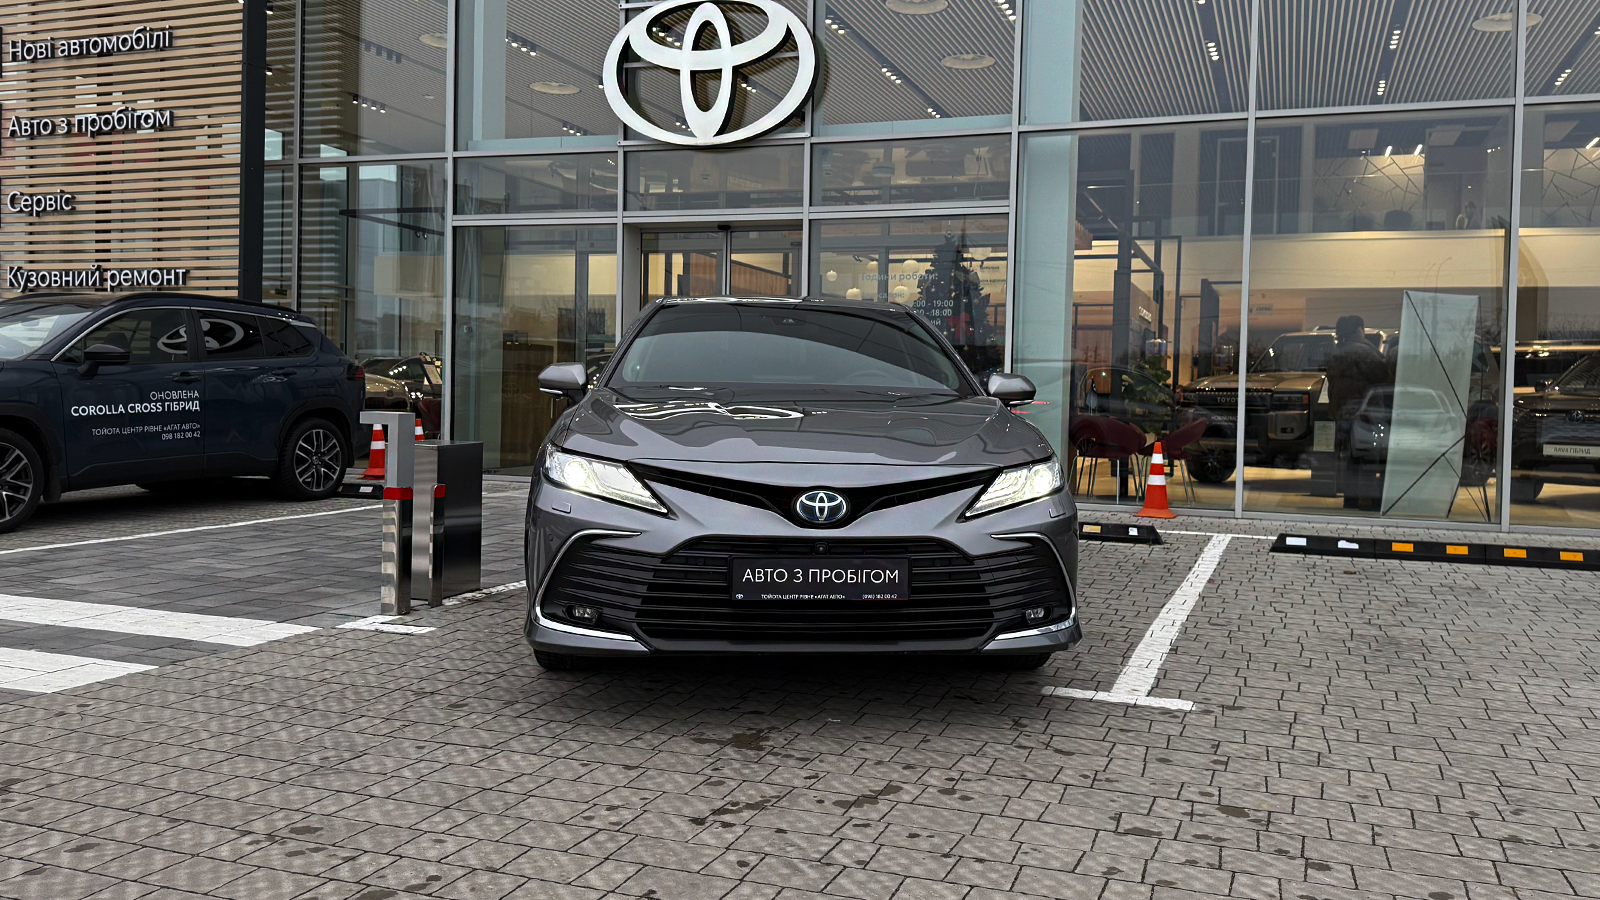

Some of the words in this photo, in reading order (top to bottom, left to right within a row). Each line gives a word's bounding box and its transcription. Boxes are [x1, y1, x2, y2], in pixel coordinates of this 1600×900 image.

[9, 36, 54, 62] Нові
[58, 25, 172, 57] автомобілі
[8, 115, 54, 137] Авто
[58, 117, 70, 135] з
[75, 106, 172, 138] пробігом
[7, 189, 74, 217] Сервіс
[6, 264, 102, 293] Кузовний
[107, 268, 187, 293] ремонт
[861, 273, 897, 282] Години
[933, 299, 954, 308] 19:00
[931, 309, 953, 317] 18:00
[150, 390, 200, 401] ОНОВЛЕНА
[70, 403, 126, 417] COROLLA
[127, 402, 163, 414] CROSS
[164, 400, 201, 413] ГІБРИД
[92, 427, 120, 436] ТОЙОТА
[121, 426, 143, 435] ЦЕНТР
[144, 424, 162, 433] РІВНЕ
[163, 423, 181, 431] «АГАТ
[182, 422, 201, 430] АВТО»
[161, 433, 173, 441] 098
[193, 430, 201, 438] 42
[742, 568, 788, 583] АВТО
[808, 569, 899, 584] ПРОБІГОМ
